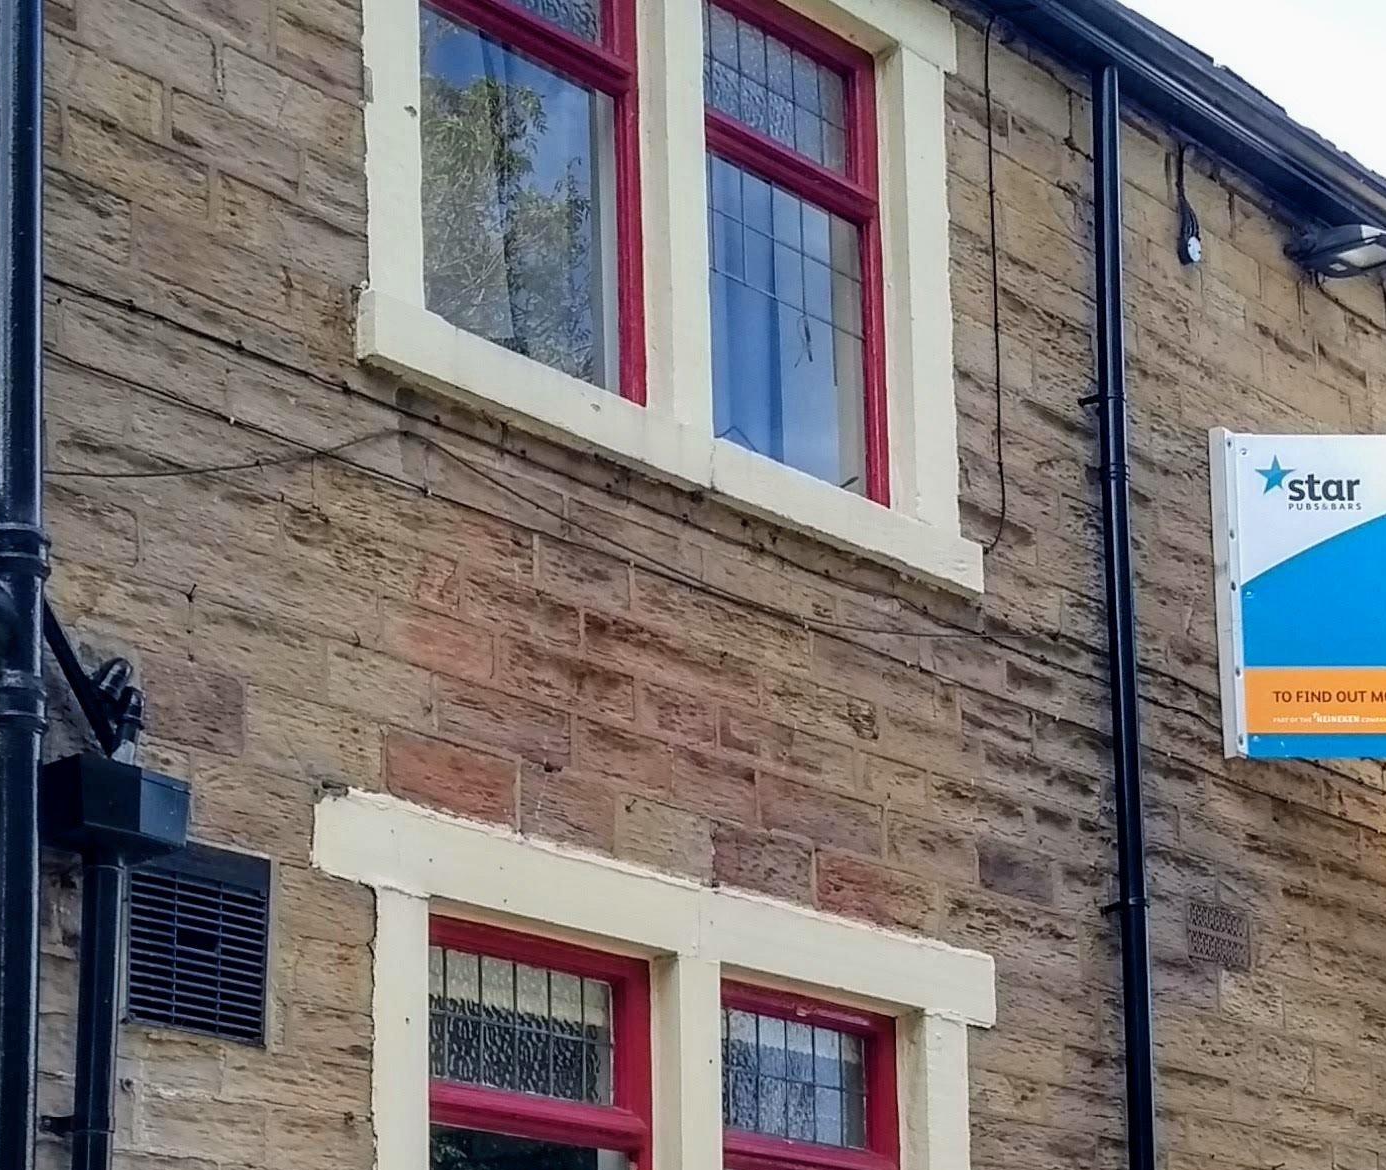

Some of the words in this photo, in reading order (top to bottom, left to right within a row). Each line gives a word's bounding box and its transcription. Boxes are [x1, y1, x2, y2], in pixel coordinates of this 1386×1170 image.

[1288, 474, 1361, 502] star
[1273, 690, 1292, 703] TO
[1296, 690, 1332, 703] FIND
[1336, 690, 1368, 703] OUT
[1316, 715, 1360, 723] HEINEKEN
